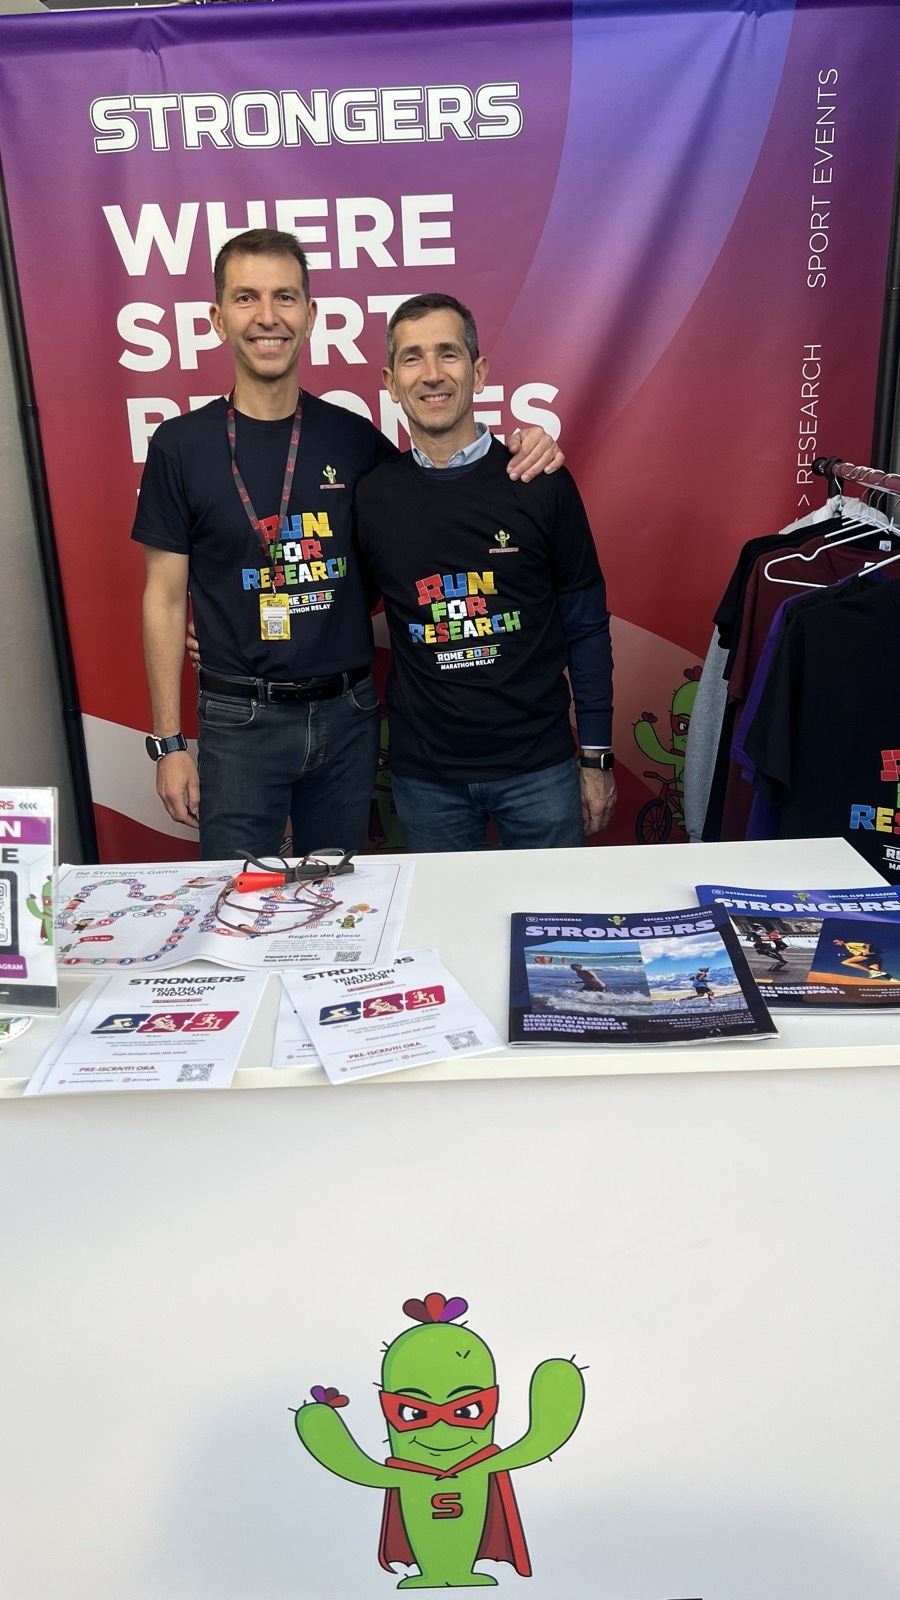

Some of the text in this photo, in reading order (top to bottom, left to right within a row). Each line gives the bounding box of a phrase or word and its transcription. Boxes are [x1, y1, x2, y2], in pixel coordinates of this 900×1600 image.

[90, 82, 523, 153] STRONGERS
[807, 68, 838, 288] SPORT EVENTS
[102, 194, 455, 276] WHERE
[116, 294, 424, 372] SPR
[796, 344, 822, 484] RESEARCH
[258, 512, 333, 544] RUN
[270, 539, 323, 564] FOR
[242, 557, 347, 590] RESEARCH
[301, 592, 332, 604] 2026
[415, 571, 497, 605] RUN
[310, 603, 330, 611] RELAY
[431, 596, 488, 622] FOR
[409, 611, 521, 644] RESEARCH
[437, 647, 497, 661] ROME 2026
[441, 658, 495, 670] MARATHON RELAY
[714, 898, 900, 913] STRONGERS
[525, 919, 715, 938] STRONGERS
[128, 976, 245, 985] STRONGERS
[332, 969, 395, 983] TRIATHLON
[344, 974, 390, 986] INDOOR
[523, 1022, 608, 1030] ULTRAMARATHON
[348, 1045, 402, 1059] PRE-ISCRIVITI
[403, 1041, 422, 1049] ORA
[431, 1492, 464, 1519] S
